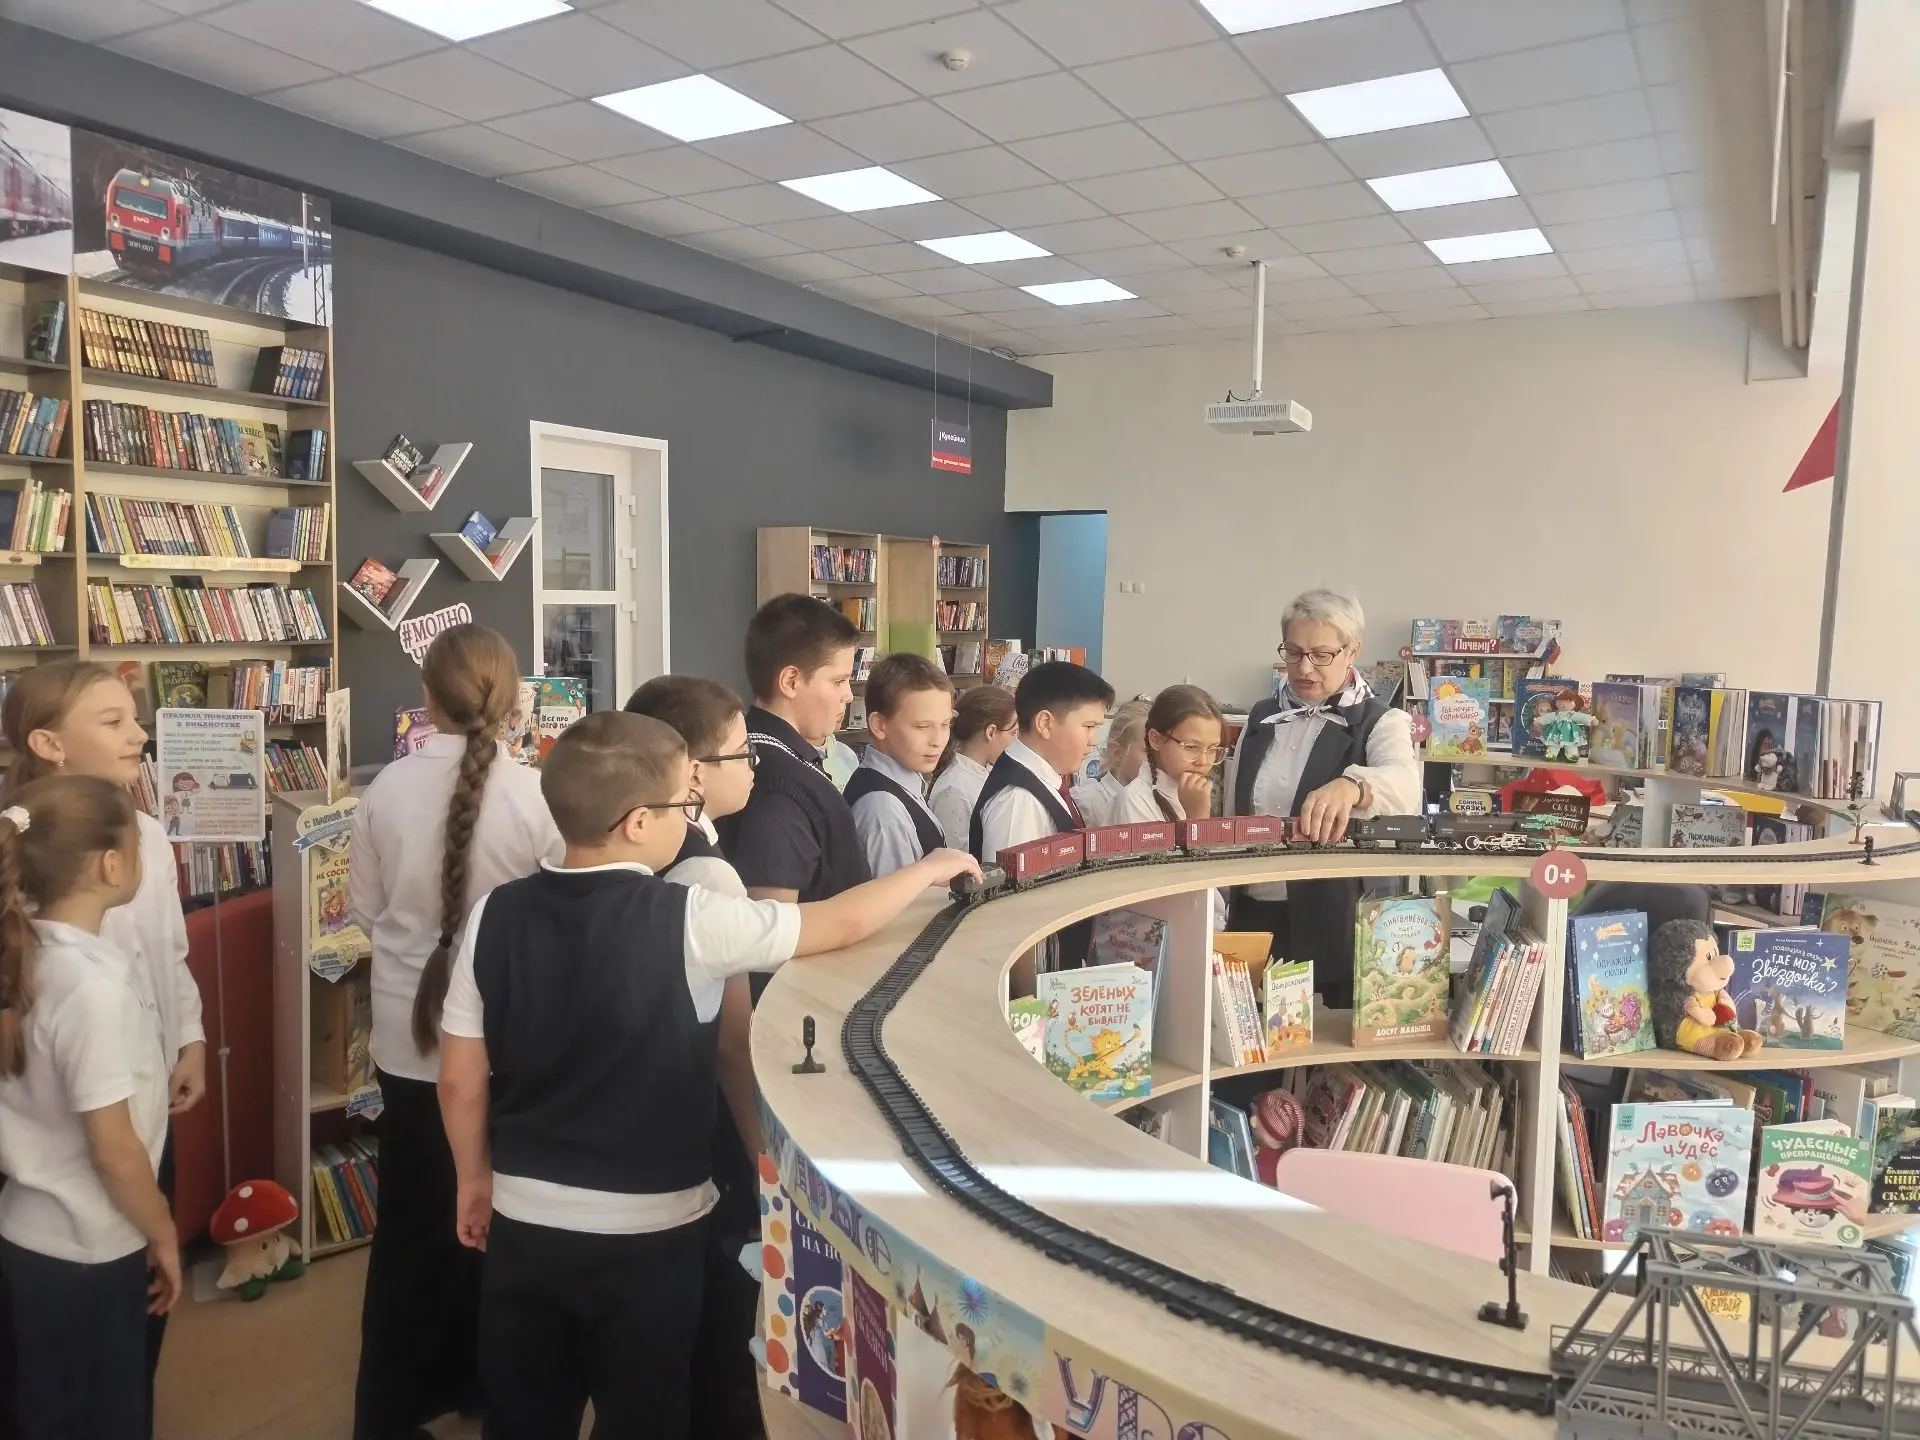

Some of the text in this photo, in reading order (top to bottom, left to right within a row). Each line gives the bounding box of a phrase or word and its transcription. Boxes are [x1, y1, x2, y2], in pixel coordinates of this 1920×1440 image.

[1454, 638, 1497, 653] Почему?
[326, 868, 350, 878] СОСКУ
[1544, 864, 1576, 884] 0+
[1772, 953, 1817, 973] ГДЕ МОЯ
[1070, 985, 1136, 1004] ЗЕЛЁНЫХ
[1080, 1003, 1131, 1017] КОТЯТ НЕ
[1088, 1015, 1128, 1026] БЫВАЕТ!
[1375, 1027, 1399, 1037] ДОСУГ
[1399, 1024, 1431, 1034] МАЛЫША
[1637, 1120, 1725, 1143] Лавочка
[1663, 1140, 1719, 1160] чудес
[1771, 1137, 1859, 1161] ЧУДЕСНЫЕ
[1780, 1150, 1850, 1167] ПРЕВРАЩЕНИЯ
[1884, 1175, 1920, 1185] КНИГ
[1882, 1191, 1920, 1201] СКАЗО
[801, 1234, 821, 1255] НА
